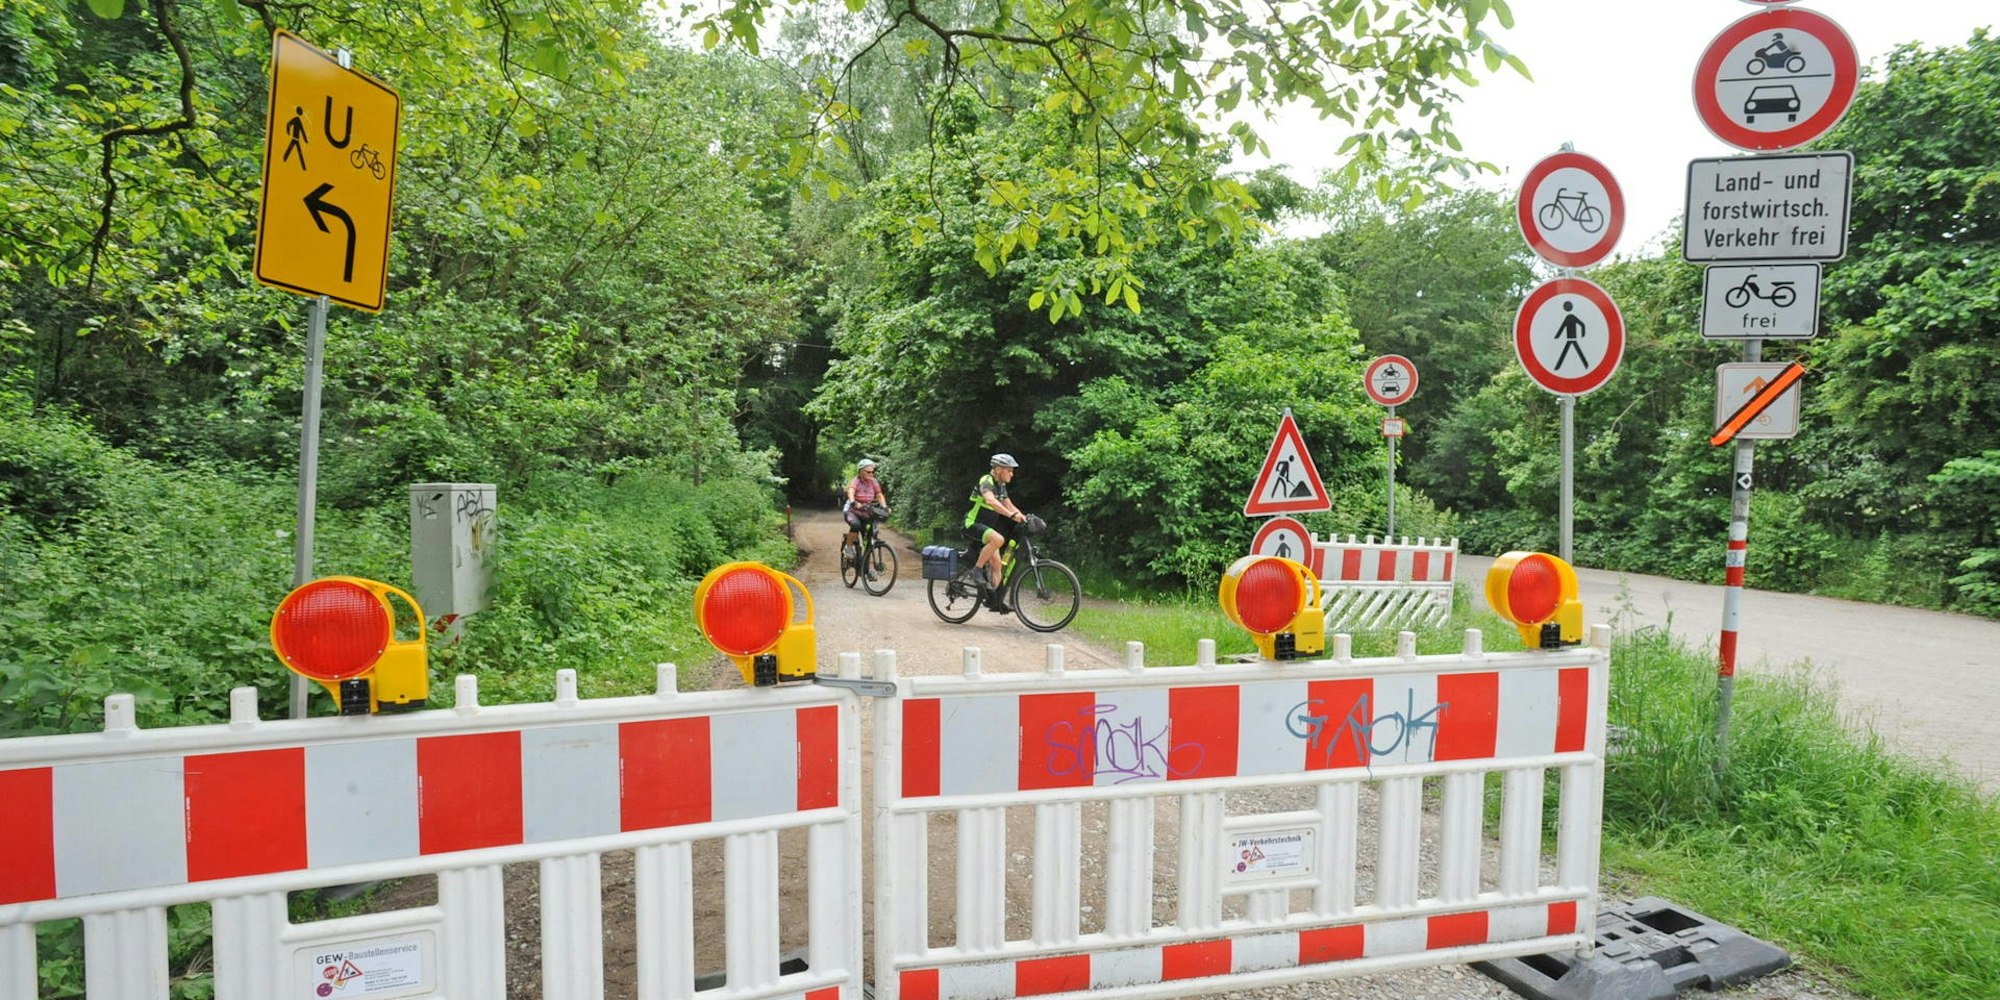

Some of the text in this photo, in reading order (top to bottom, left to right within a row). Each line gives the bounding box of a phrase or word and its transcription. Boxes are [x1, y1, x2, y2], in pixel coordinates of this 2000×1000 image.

[324, 95, 353, 149] U
[1715, 169, 1820, 192] Land- und
[1703, 198, 1829, 220] forstwirtsch.
[1704, 226, 1825, 248] Verkehr frei
[1743, 313, 1777, 328] frei
[1238, 835, 1302, 848] JW-Verkehrstechnik
